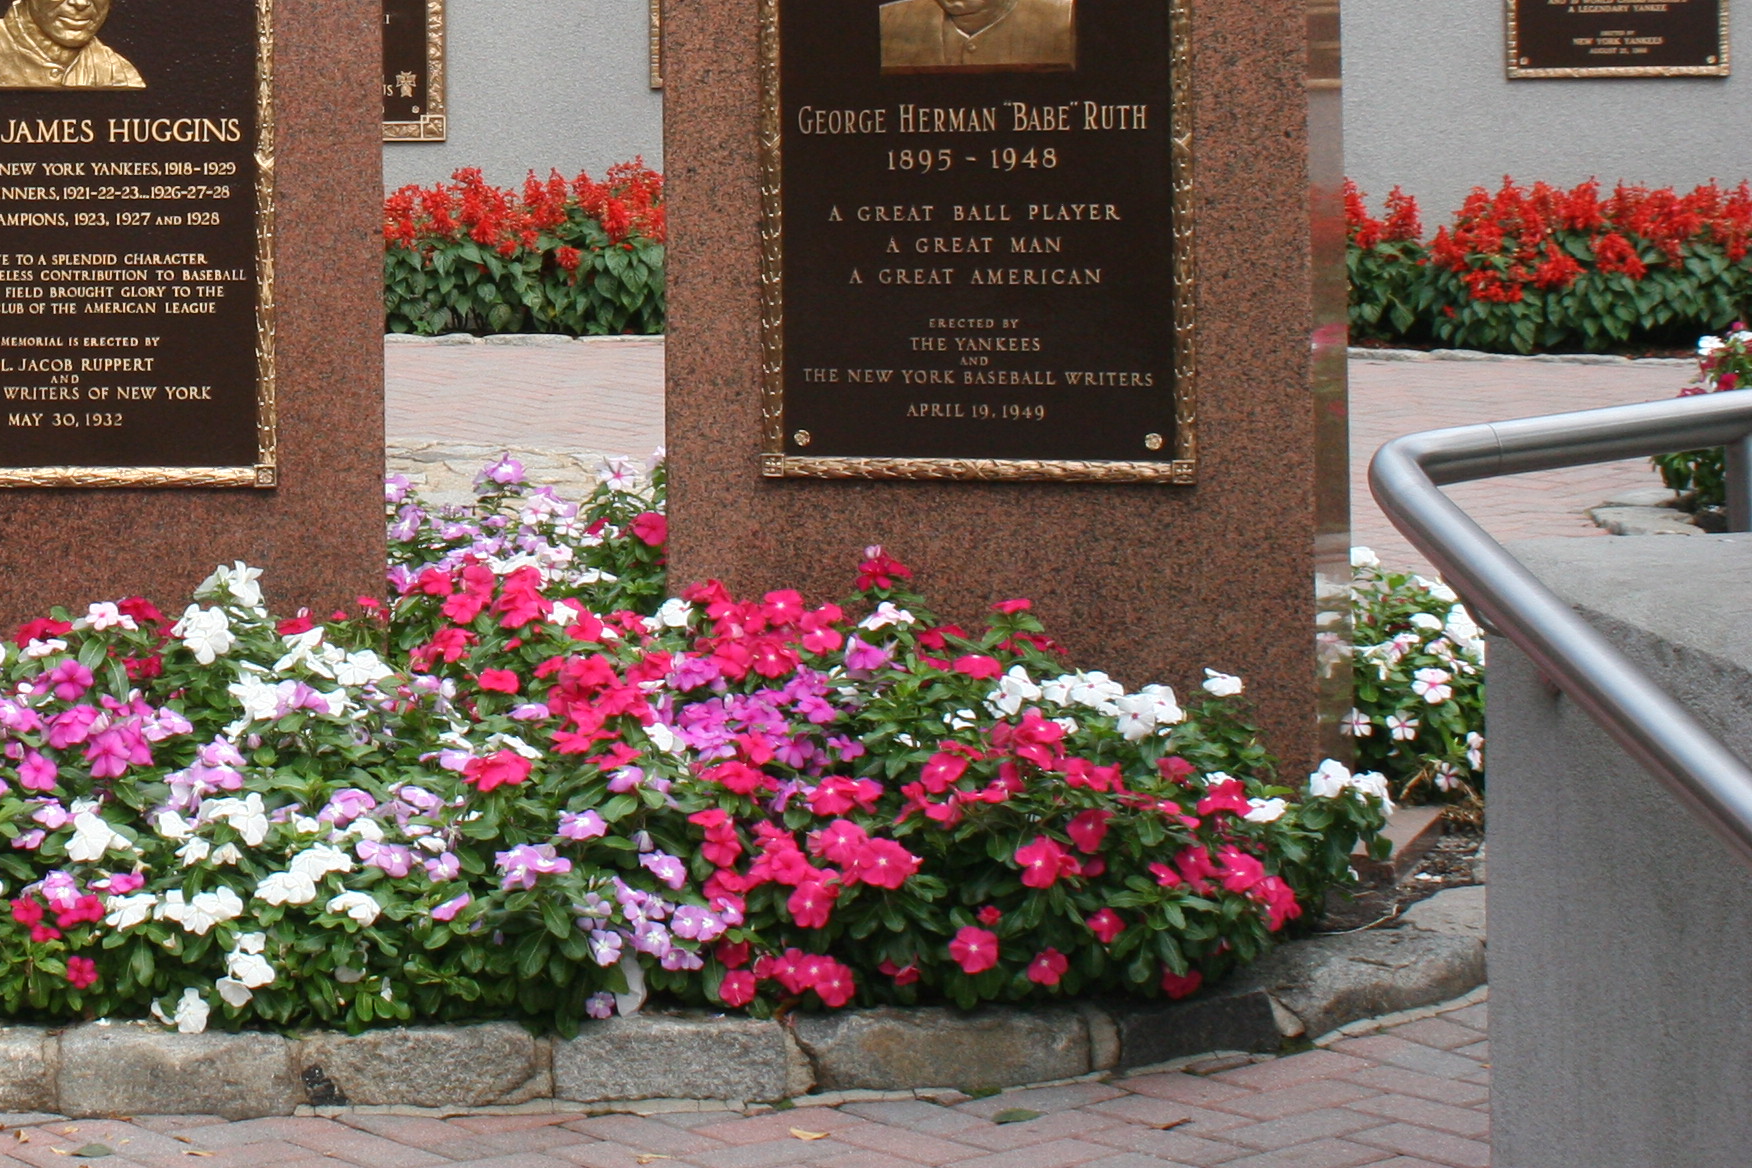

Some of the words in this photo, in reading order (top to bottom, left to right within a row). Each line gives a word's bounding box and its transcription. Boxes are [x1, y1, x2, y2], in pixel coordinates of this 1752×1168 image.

[799, 106, 886, 134] GEORGE
[900, 104, 995, 132] HERMAN
[1084, 101, 1146, 129] RUTH
[1, 119, 94, 143] JAMES
[109, 119, 240, 142] HUGGINS
[0, 163, 36, 175] NEW
[42, 163, 85, 175] YORK
[91, 163, 161, 175] YANKEES,
[165, 162, 236, 175] 1918-1929
[829, 206, 843, 221] A
[858, 206, 933, 221] GREAT
[954, 205, 1010, 221] BALL
[1029, 204, 1120, 220] PLAYER
[887, 237, 900, 253] A
[916, 238, 993, 253] GREAT
[1011, 237, 1060, 253] MAN
[850, 268, 863, 283] A
[879, 269, 954, 284] GREAT
[971, 269, 1101, 284] AMERICAN
[910, 337, 947, 351] THE
[955, 338, 1040, 351] YANKEES
[18, 359, 72, 371] JACOB
[82, 358, 154, 371] RUPPERT
[961, 356, 989, 366] AND
[51, 375, 79, 383] AND
[804, 368, 838, 382] THE
[848, 369, 893, 383] NEW
[902, 370, 954, 384] YORK
[964, 371, 1056, 385] BASEBALL
[1065, 372, 1153, 386] WRITERS
[4, 387, 79, 400] WRITERS
[88, 387, 108, 399] OF
[117, 387, 156, 399] NEW
[165, 386, 211, 399] YORK
[907, 404, 964, 417] APRIL
[972, 404, 995, 419] 19,
[1003, 405, 1044, 420] 1949
